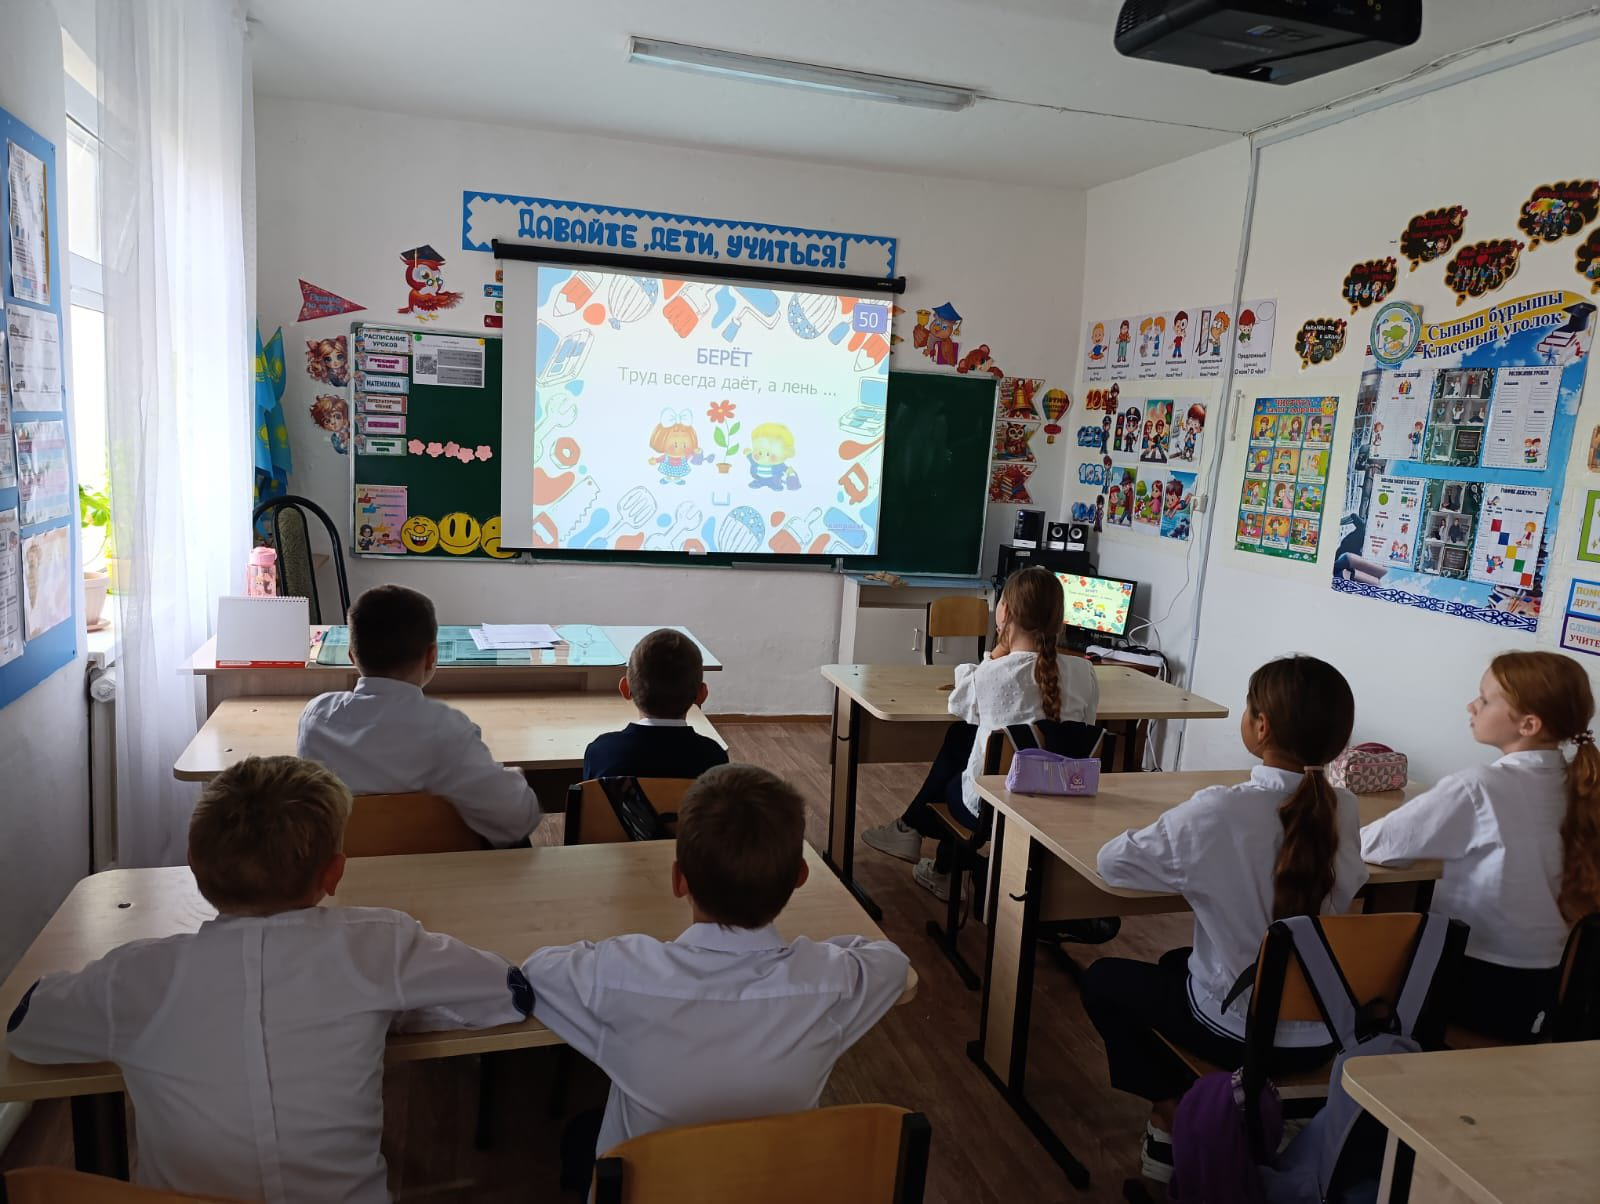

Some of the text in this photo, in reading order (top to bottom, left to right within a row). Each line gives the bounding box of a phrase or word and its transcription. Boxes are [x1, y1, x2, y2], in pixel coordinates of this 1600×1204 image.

[726, 234, 848, 269] УЧИТЬСЯ!
[858, 310, 879, 330] 50
[1428, 316, 1484, 341] Сынып
[364, 333, 407, 342] РАСПИСАНИЕ
[1422, 312, 1562, 359] Классный уголок
[696, 346, 753, 368] БЕРЁТ
[366, 379, 401, 388] МАТЕМАТИКА
[617, 366, 658, 386] Труд
[663, 372, 716, 390] всегда
[721, 375, 763, 393] даёт,
[767, 381, 777, 393] а
[781, 379, 818, 396] лень
